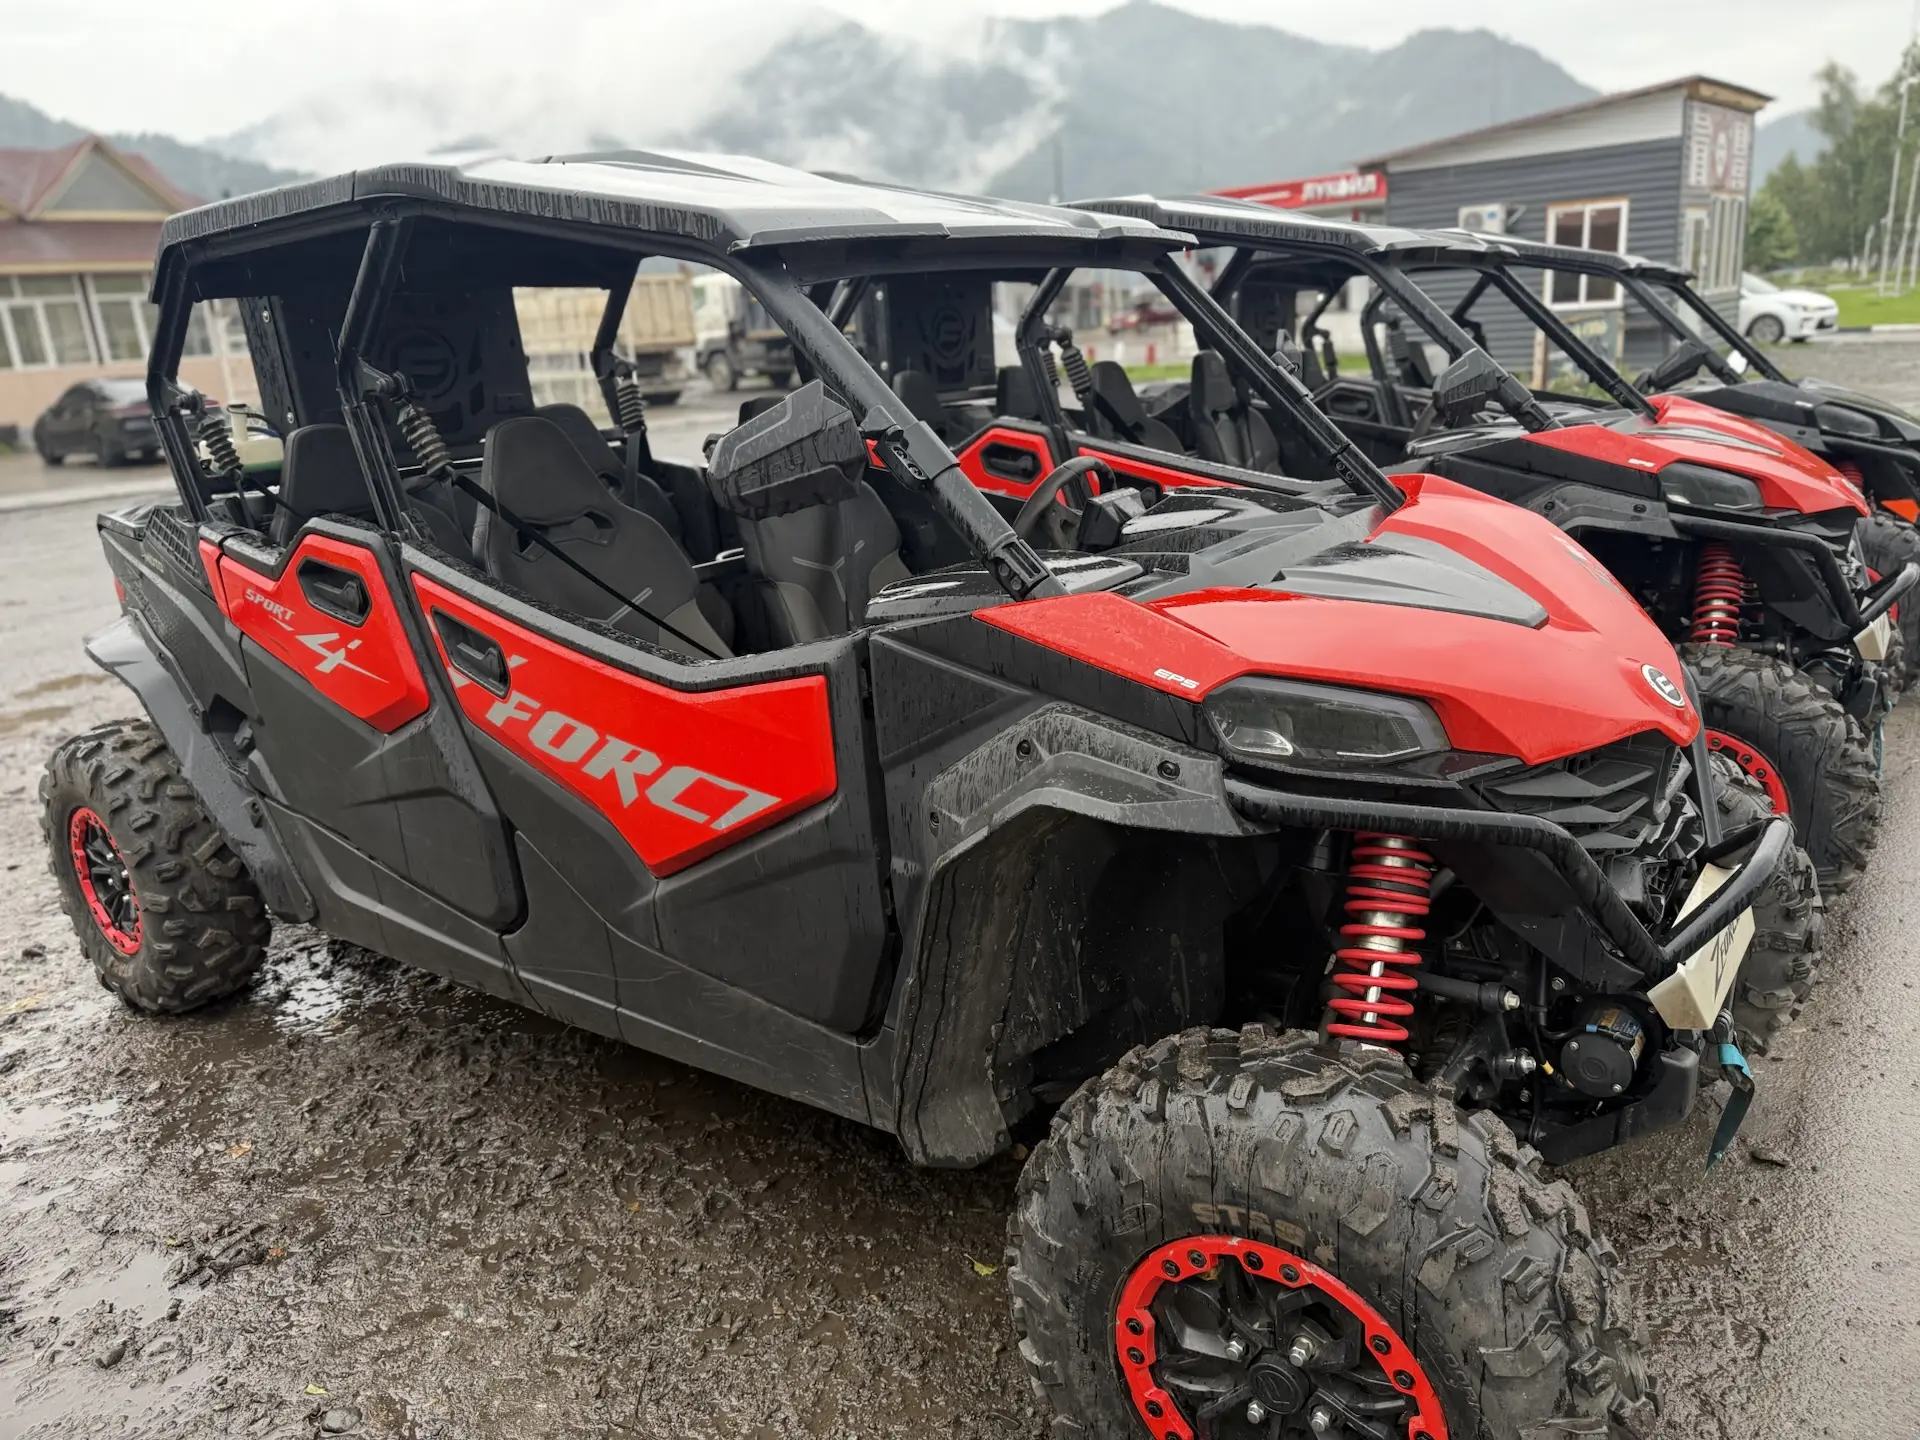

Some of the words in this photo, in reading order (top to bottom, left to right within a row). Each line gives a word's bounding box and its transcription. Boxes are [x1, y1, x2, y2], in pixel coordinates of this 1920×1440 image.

[244, 588, 296, 622] SPORT
[1153, 668, 1200, 689] EPS
[447, 654, 783, 831] FORC
